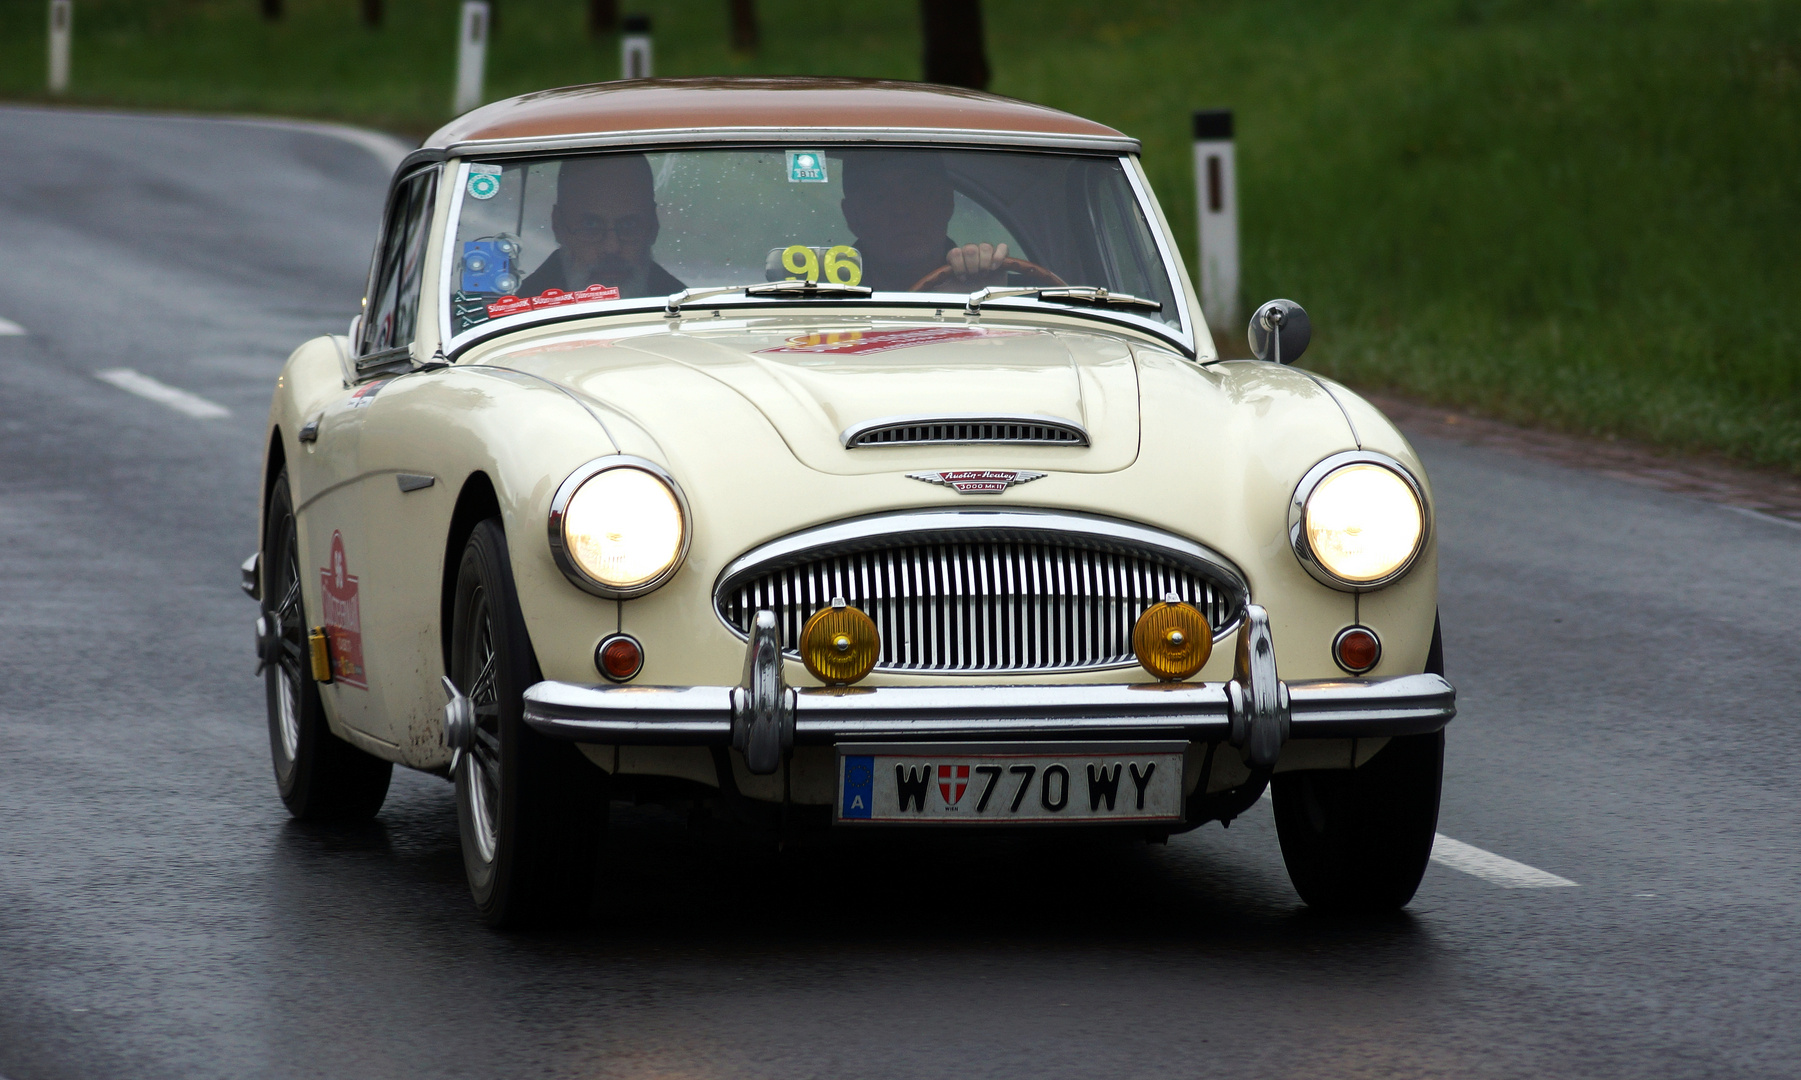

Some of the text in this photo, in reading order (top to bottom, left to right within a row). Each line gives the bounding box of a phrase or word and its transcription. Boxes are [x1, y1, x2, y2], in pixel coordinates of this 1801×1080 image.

[782, 245, 862, 287] 96
[945, 471, 1015, 481] Austin-Healey
[895, 761, 1157, 813] W 770 WY
[851, 794, 865, 809] A
